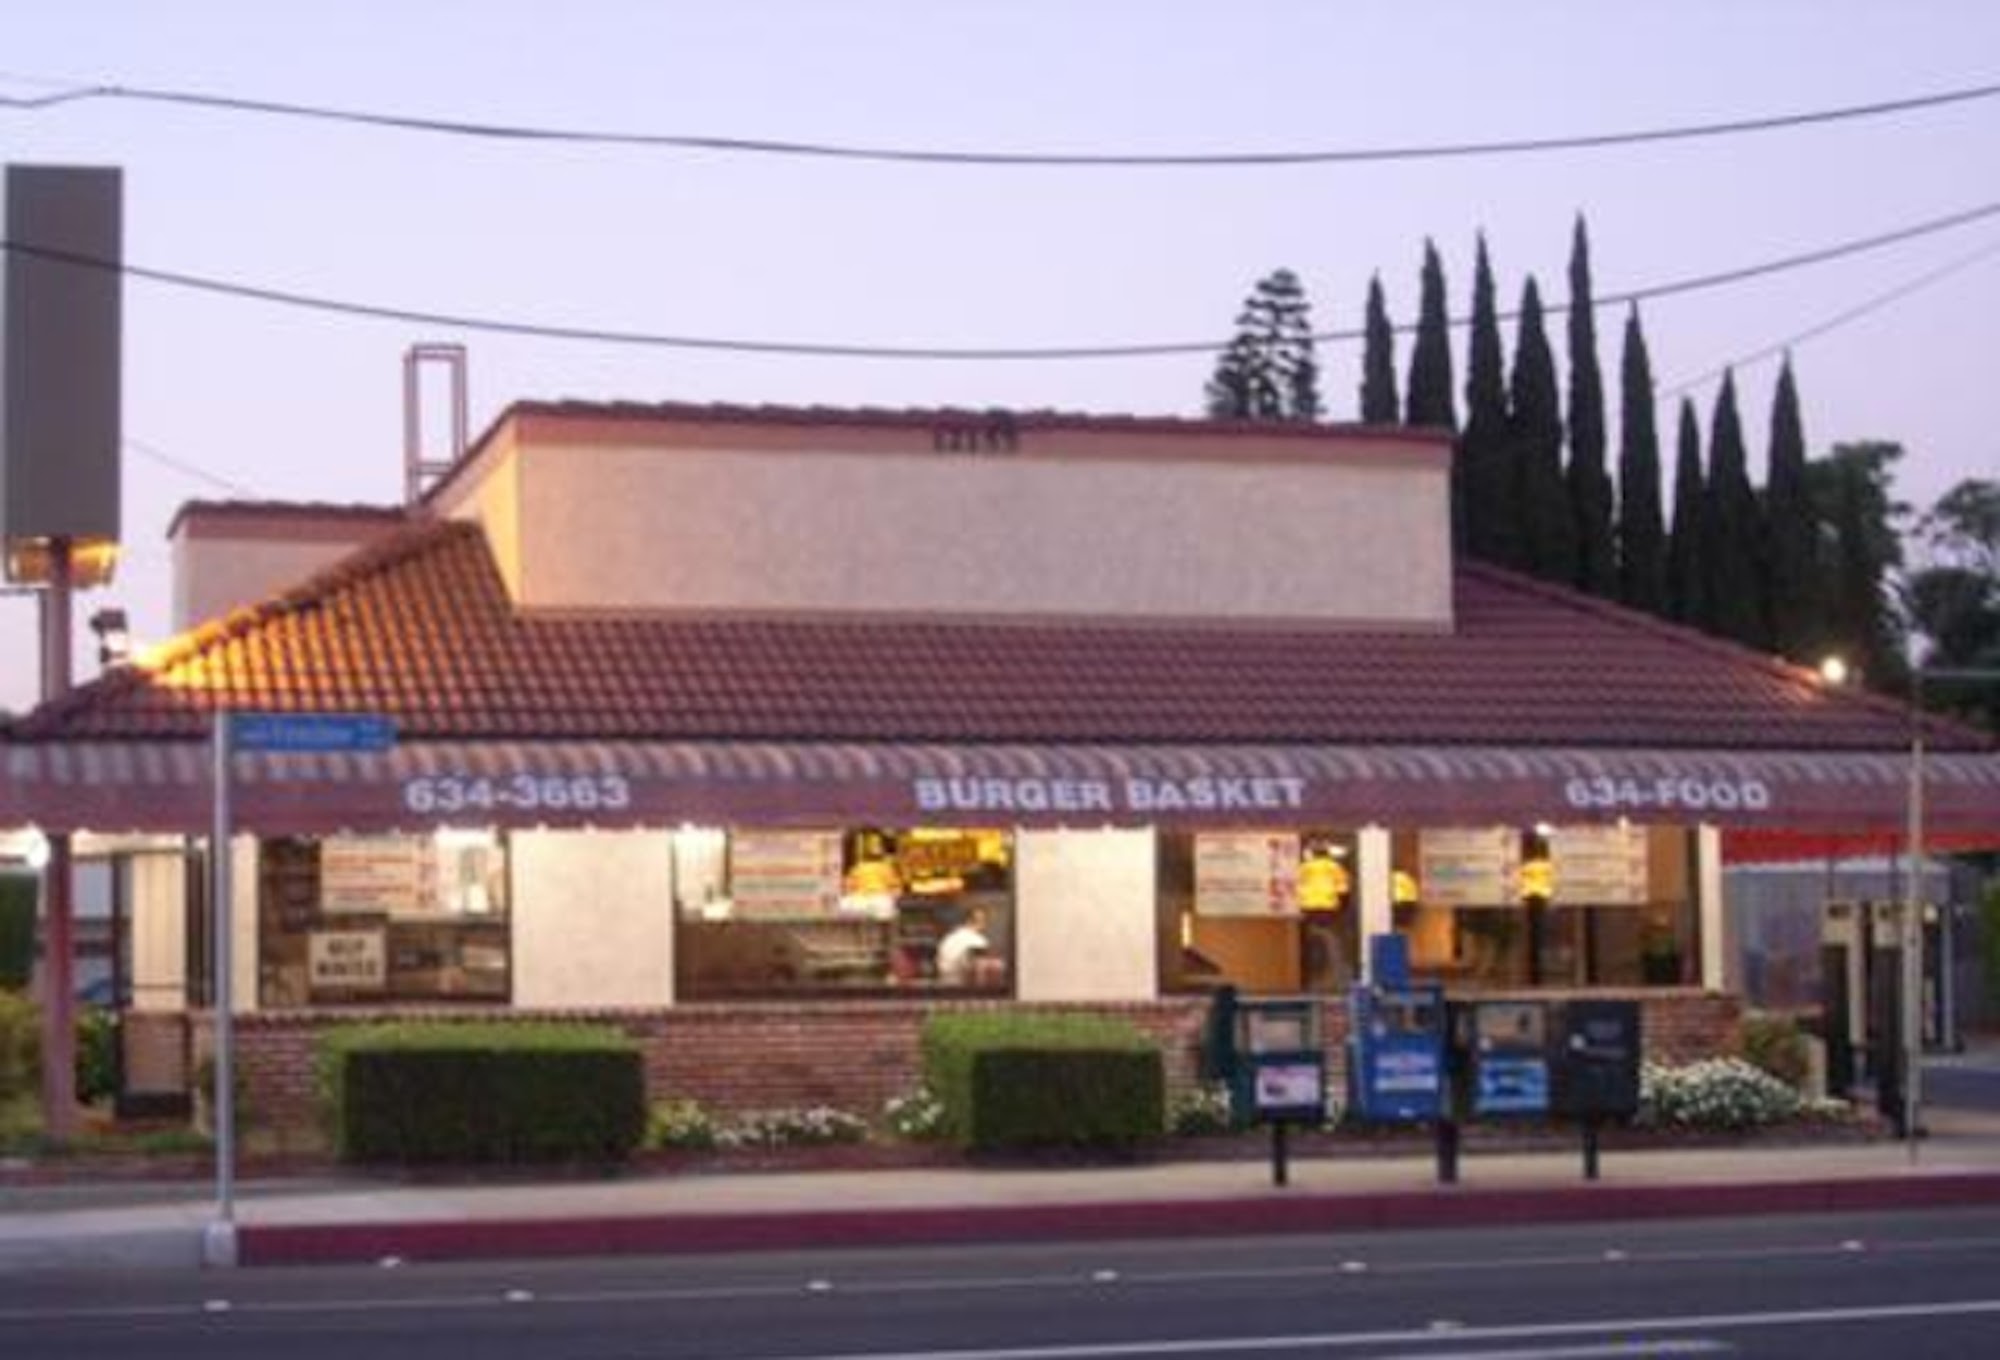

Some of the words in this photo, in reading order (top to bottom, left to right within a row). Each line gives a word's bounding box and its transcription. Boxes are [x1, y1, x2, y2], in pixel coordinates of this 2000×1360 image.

[405, 776, 630, 812] 634-3663
[915, 776, 1111, 811] BURGER
[1126, 776, 1305, 809] BASKET
[1565, 776, 1769, 811] 634-FOOD
